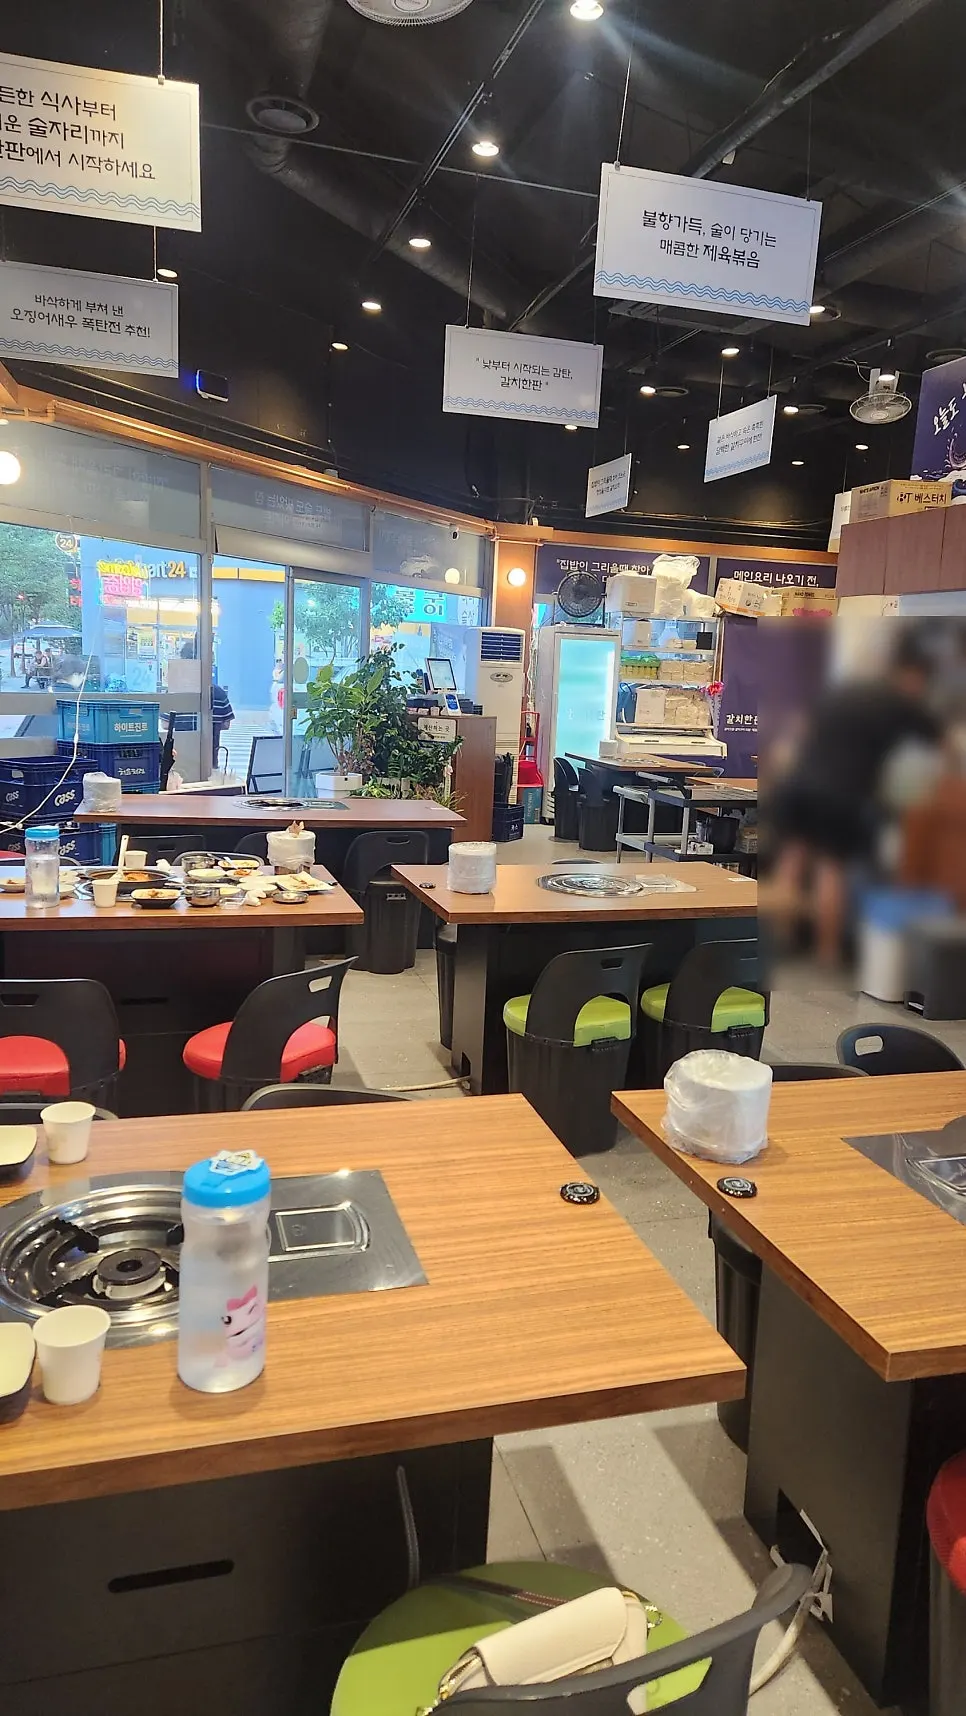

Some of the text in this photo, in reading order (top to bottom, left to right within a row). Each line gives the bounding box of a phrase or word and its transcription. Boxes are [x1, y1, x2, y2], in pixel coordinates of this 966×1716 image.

[41, 91, 117, 121] 식사부터
[0, 114, 124, 149] 운 술자리까지
[68, 153, 156, 180] 시작하세요
[642, 209, 777, 248] 불향가득, 술이 당기는
[659, 239, 760, 269] 매콤한 제육볶음
[34, 294, 124, 317] 바삭하게 부쳐 낸
[10, 308, 151, 338] 오징어새우 폭탄전 추천!
[513, 362, 550, 377] 시작되는
[933, 397, 960, 436] 오늘도
[914, 492, 947, 505] 베스터치
[60, 538, 73, 548] 24
[733, 570, 773, 584] 메인요리
[775, 573, 805, 586] 나오기
[114, 722, 149, 732] 하이트진로
[54, 789, 76, 807] Cass
[58, 840, 76, 856] ass
